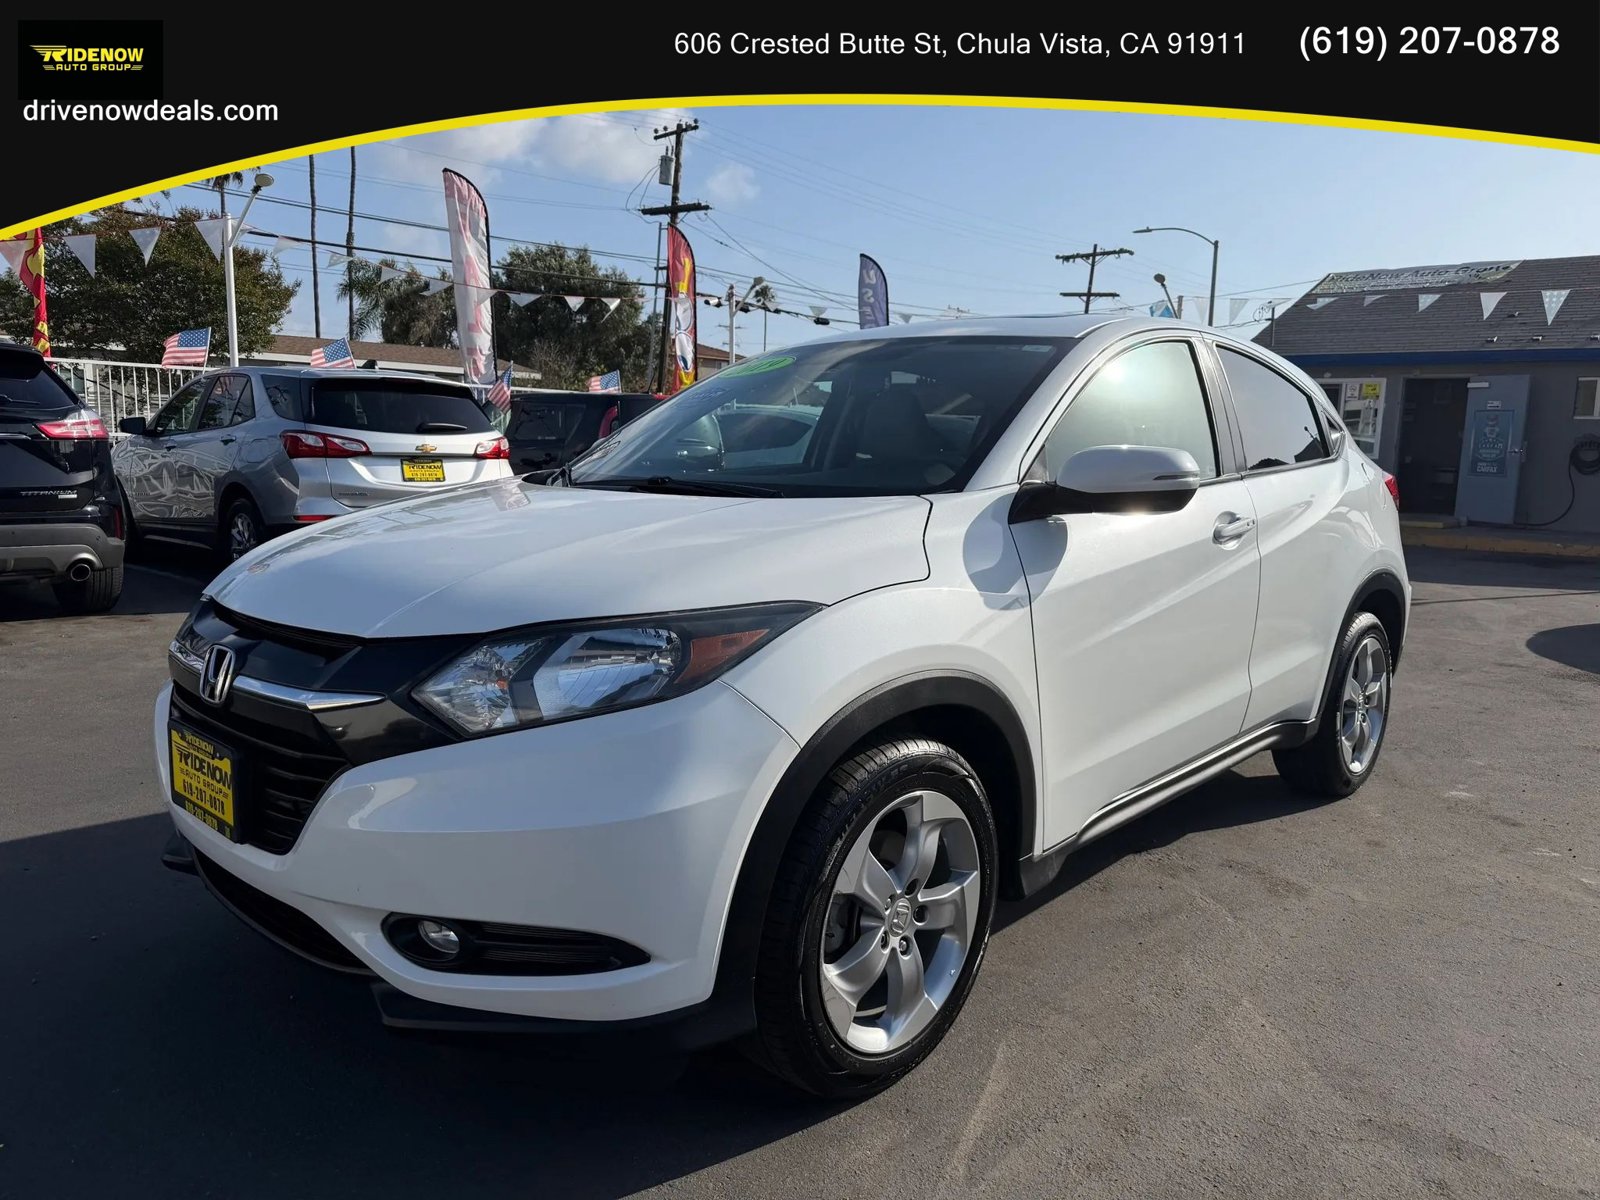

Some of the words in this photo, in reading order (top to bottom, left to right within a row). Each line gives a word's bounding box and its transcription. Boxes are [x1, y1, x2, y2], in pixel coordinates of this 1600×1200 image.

[175, 745, 232, 790] RIDENOW
[184, 770, 201, 785] AUTO
[203, 779, 223, 797] GROUP
